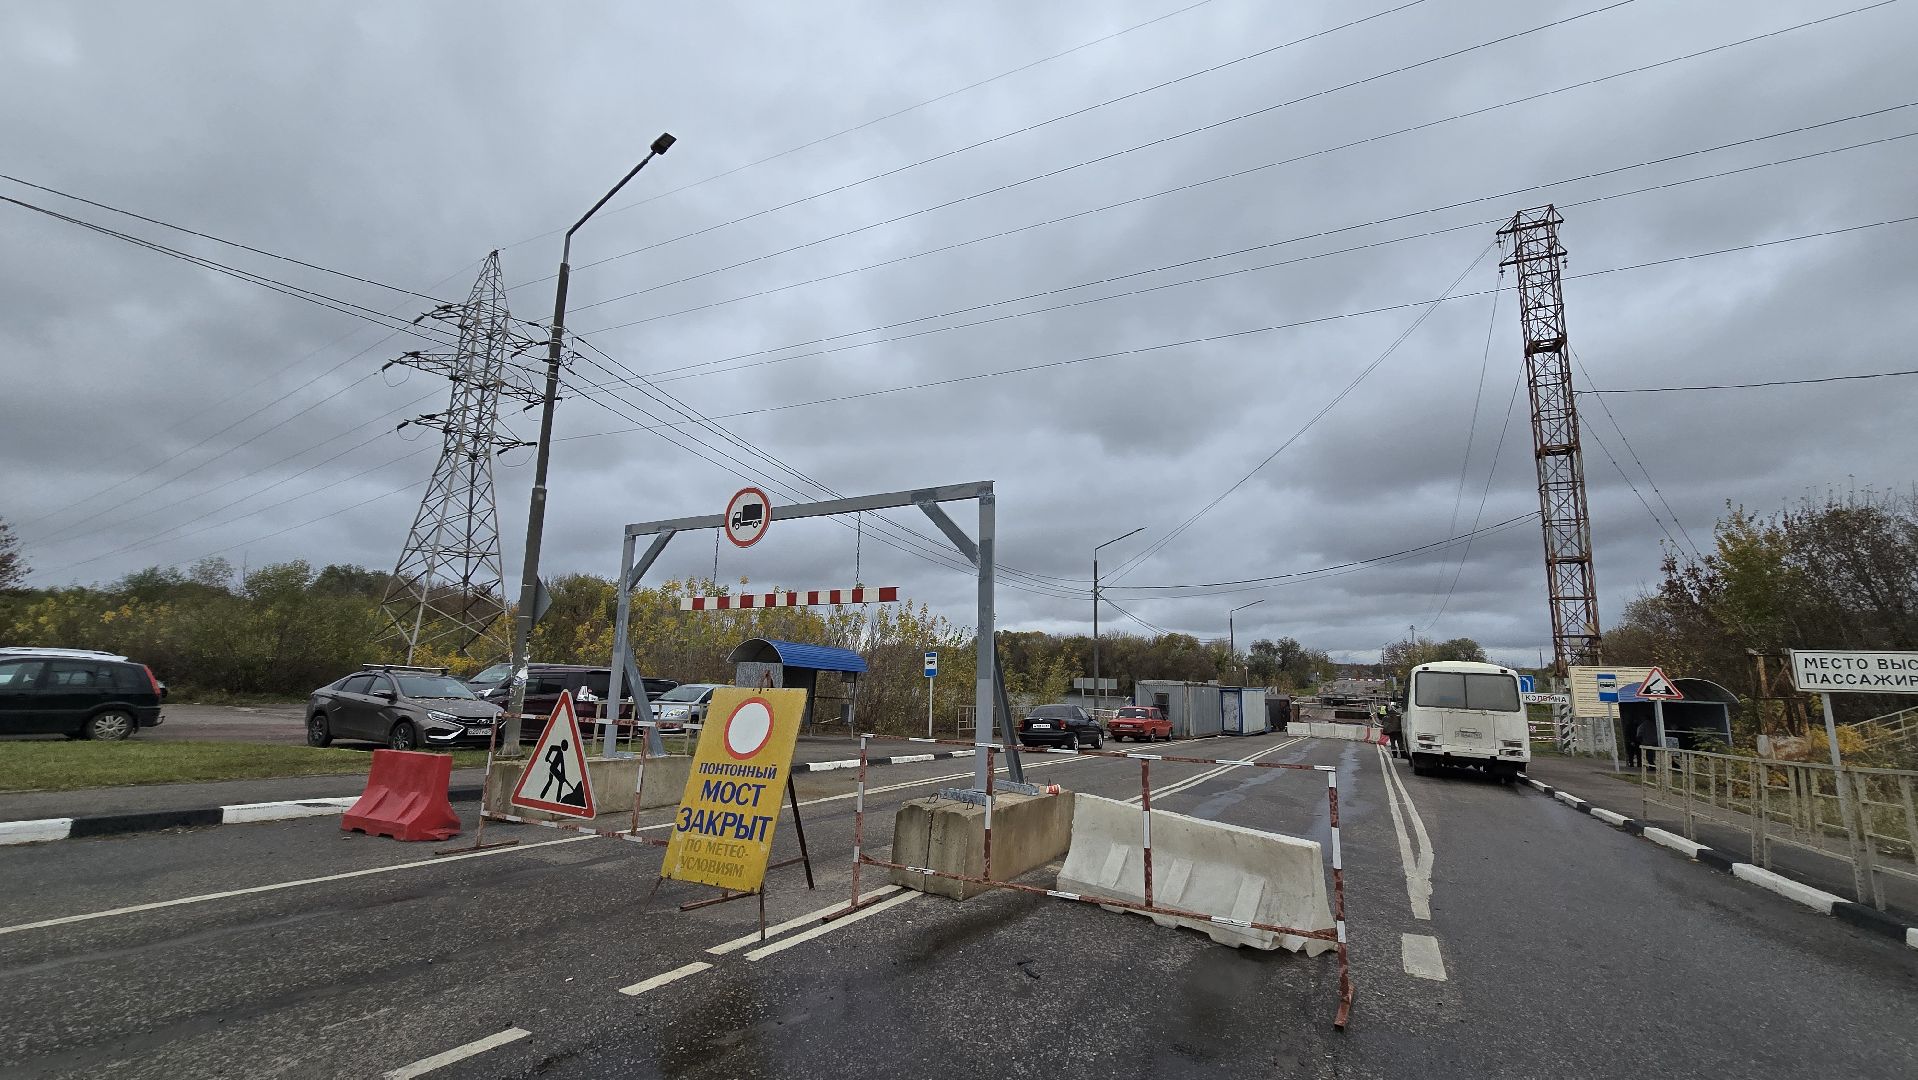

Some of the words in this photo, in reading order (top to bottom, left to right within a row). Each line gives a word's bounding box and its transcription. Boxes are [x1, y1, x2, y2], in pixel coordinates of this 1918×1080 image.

[1804, 657, 1868, 670] МЕСТО
[1876, 658, 1918, 671] ВЫС
[1806, 673, 1918, 686] ПАССАЖИР
[699, 763, 777, 779] ПОНТОННЫЙ
[700, 780, 766, 807] МОСТ
[676, 806, 773, 842] ЗАКРЫТ
[685, 839, 702, 853] ПО
[680, 855, 745, 878] УСЛОВИЯМ
